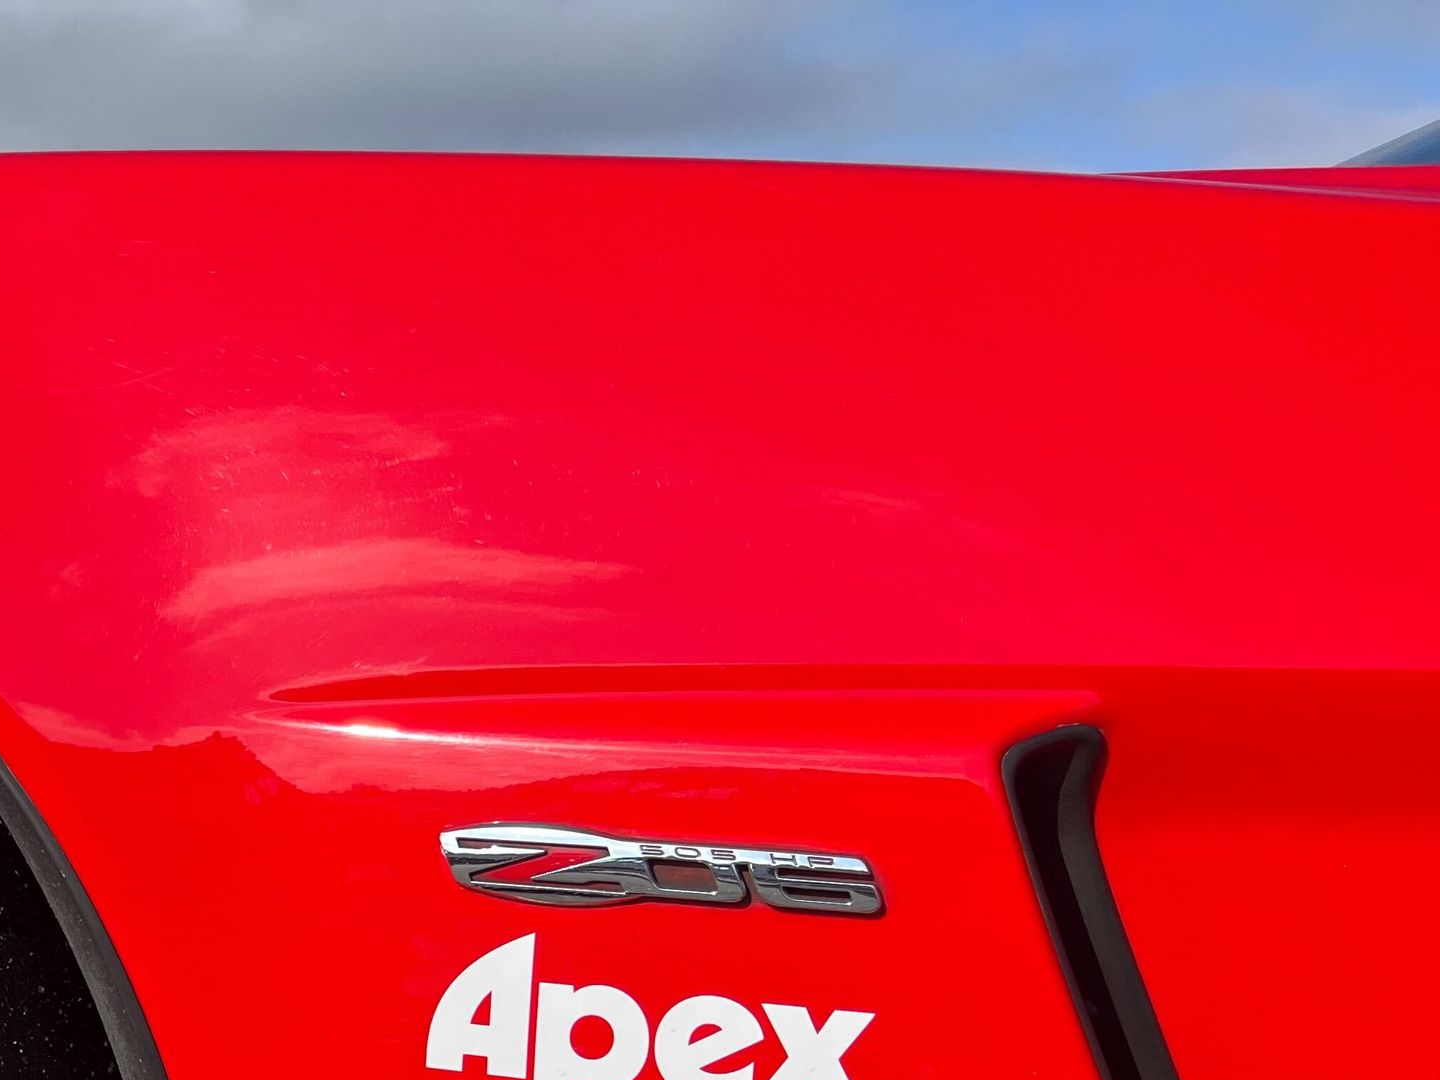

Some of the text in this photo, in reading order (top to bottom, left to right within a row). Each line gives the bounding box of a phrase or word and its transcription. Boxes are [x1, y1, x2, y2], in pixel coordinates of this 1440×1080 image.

[440, 820, 882, 914] Z06
[639, 844, 834, 867] 505 HP
